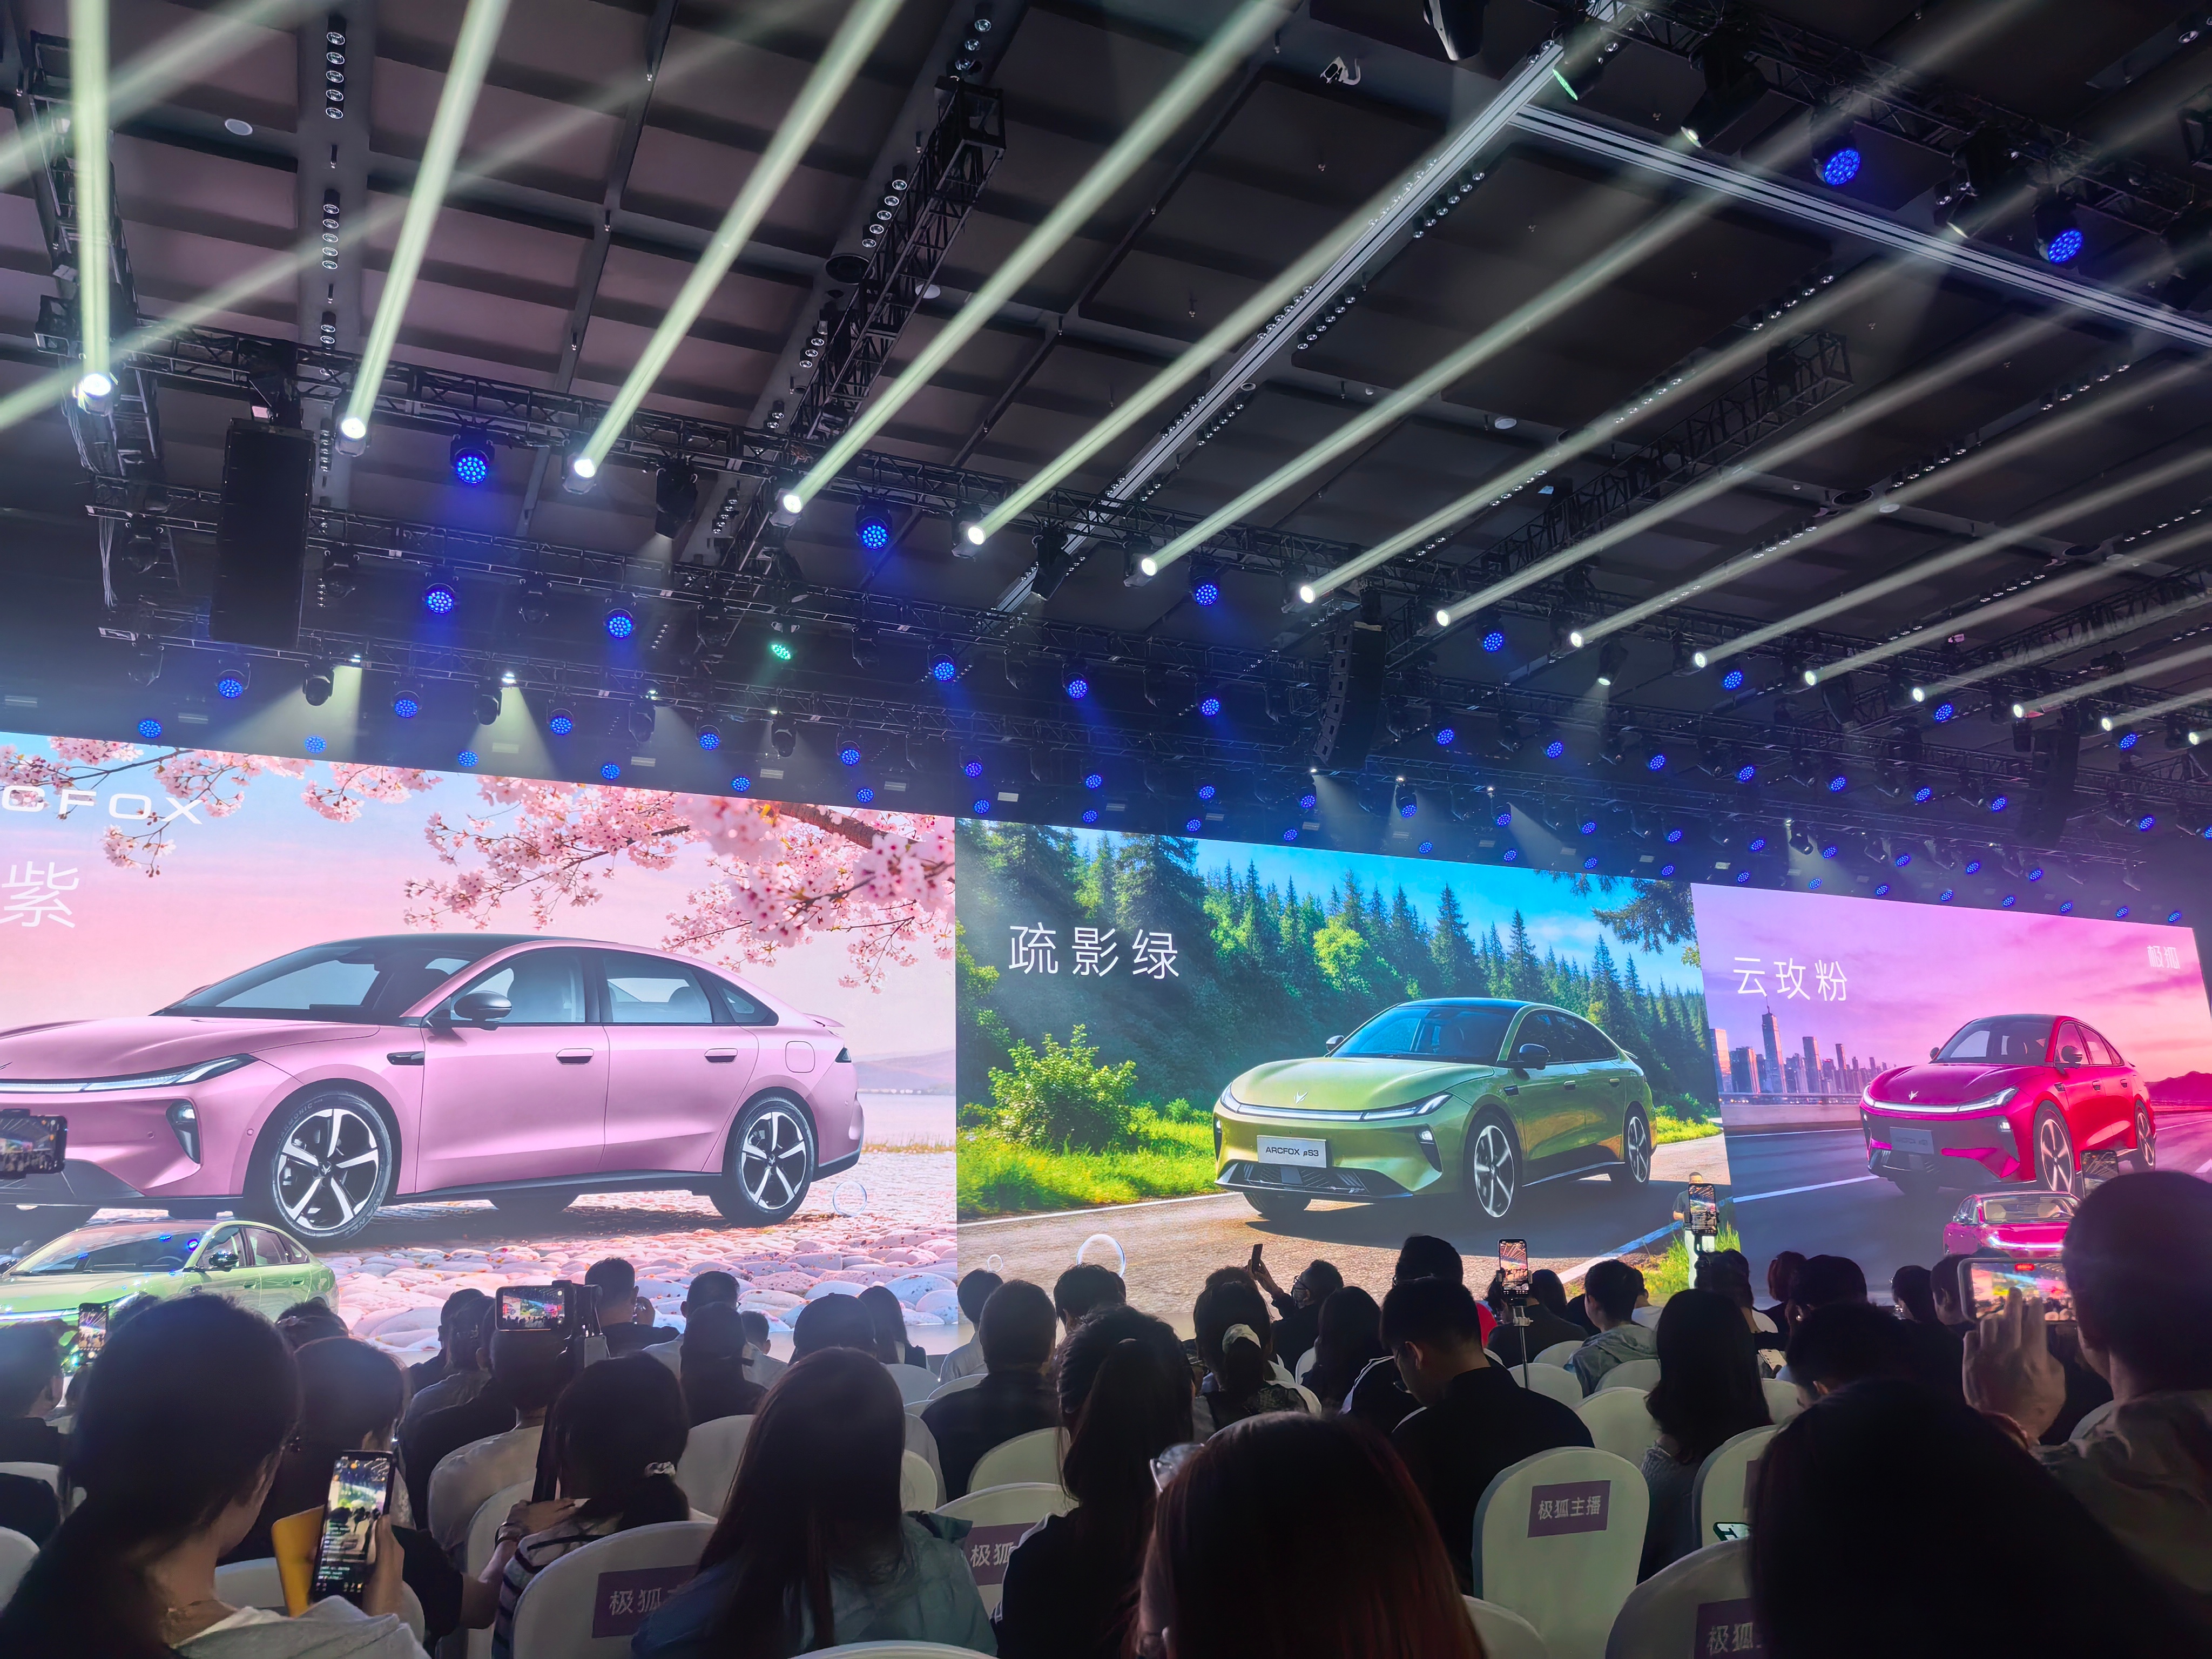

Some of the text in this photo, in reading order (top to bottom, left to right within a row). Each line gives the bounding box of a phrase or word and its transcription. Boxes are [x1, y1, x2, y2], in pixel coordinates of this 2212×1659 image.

[0, 861, 79, 928] 紫
[1009, 922, 1179, 979] 疏影绿
[2147, 945, 2180, 969] 极狐
[1733, 957, 1847, 1001] 云玫粉
[1265, 1147, 1300, 1156] ARCFOX
[1538, 1495, 1601, 1520] 极狐主播
[609, 1587, 676, 1615] 极狐
[1707, 1622, 1762, 1656] 极狐
